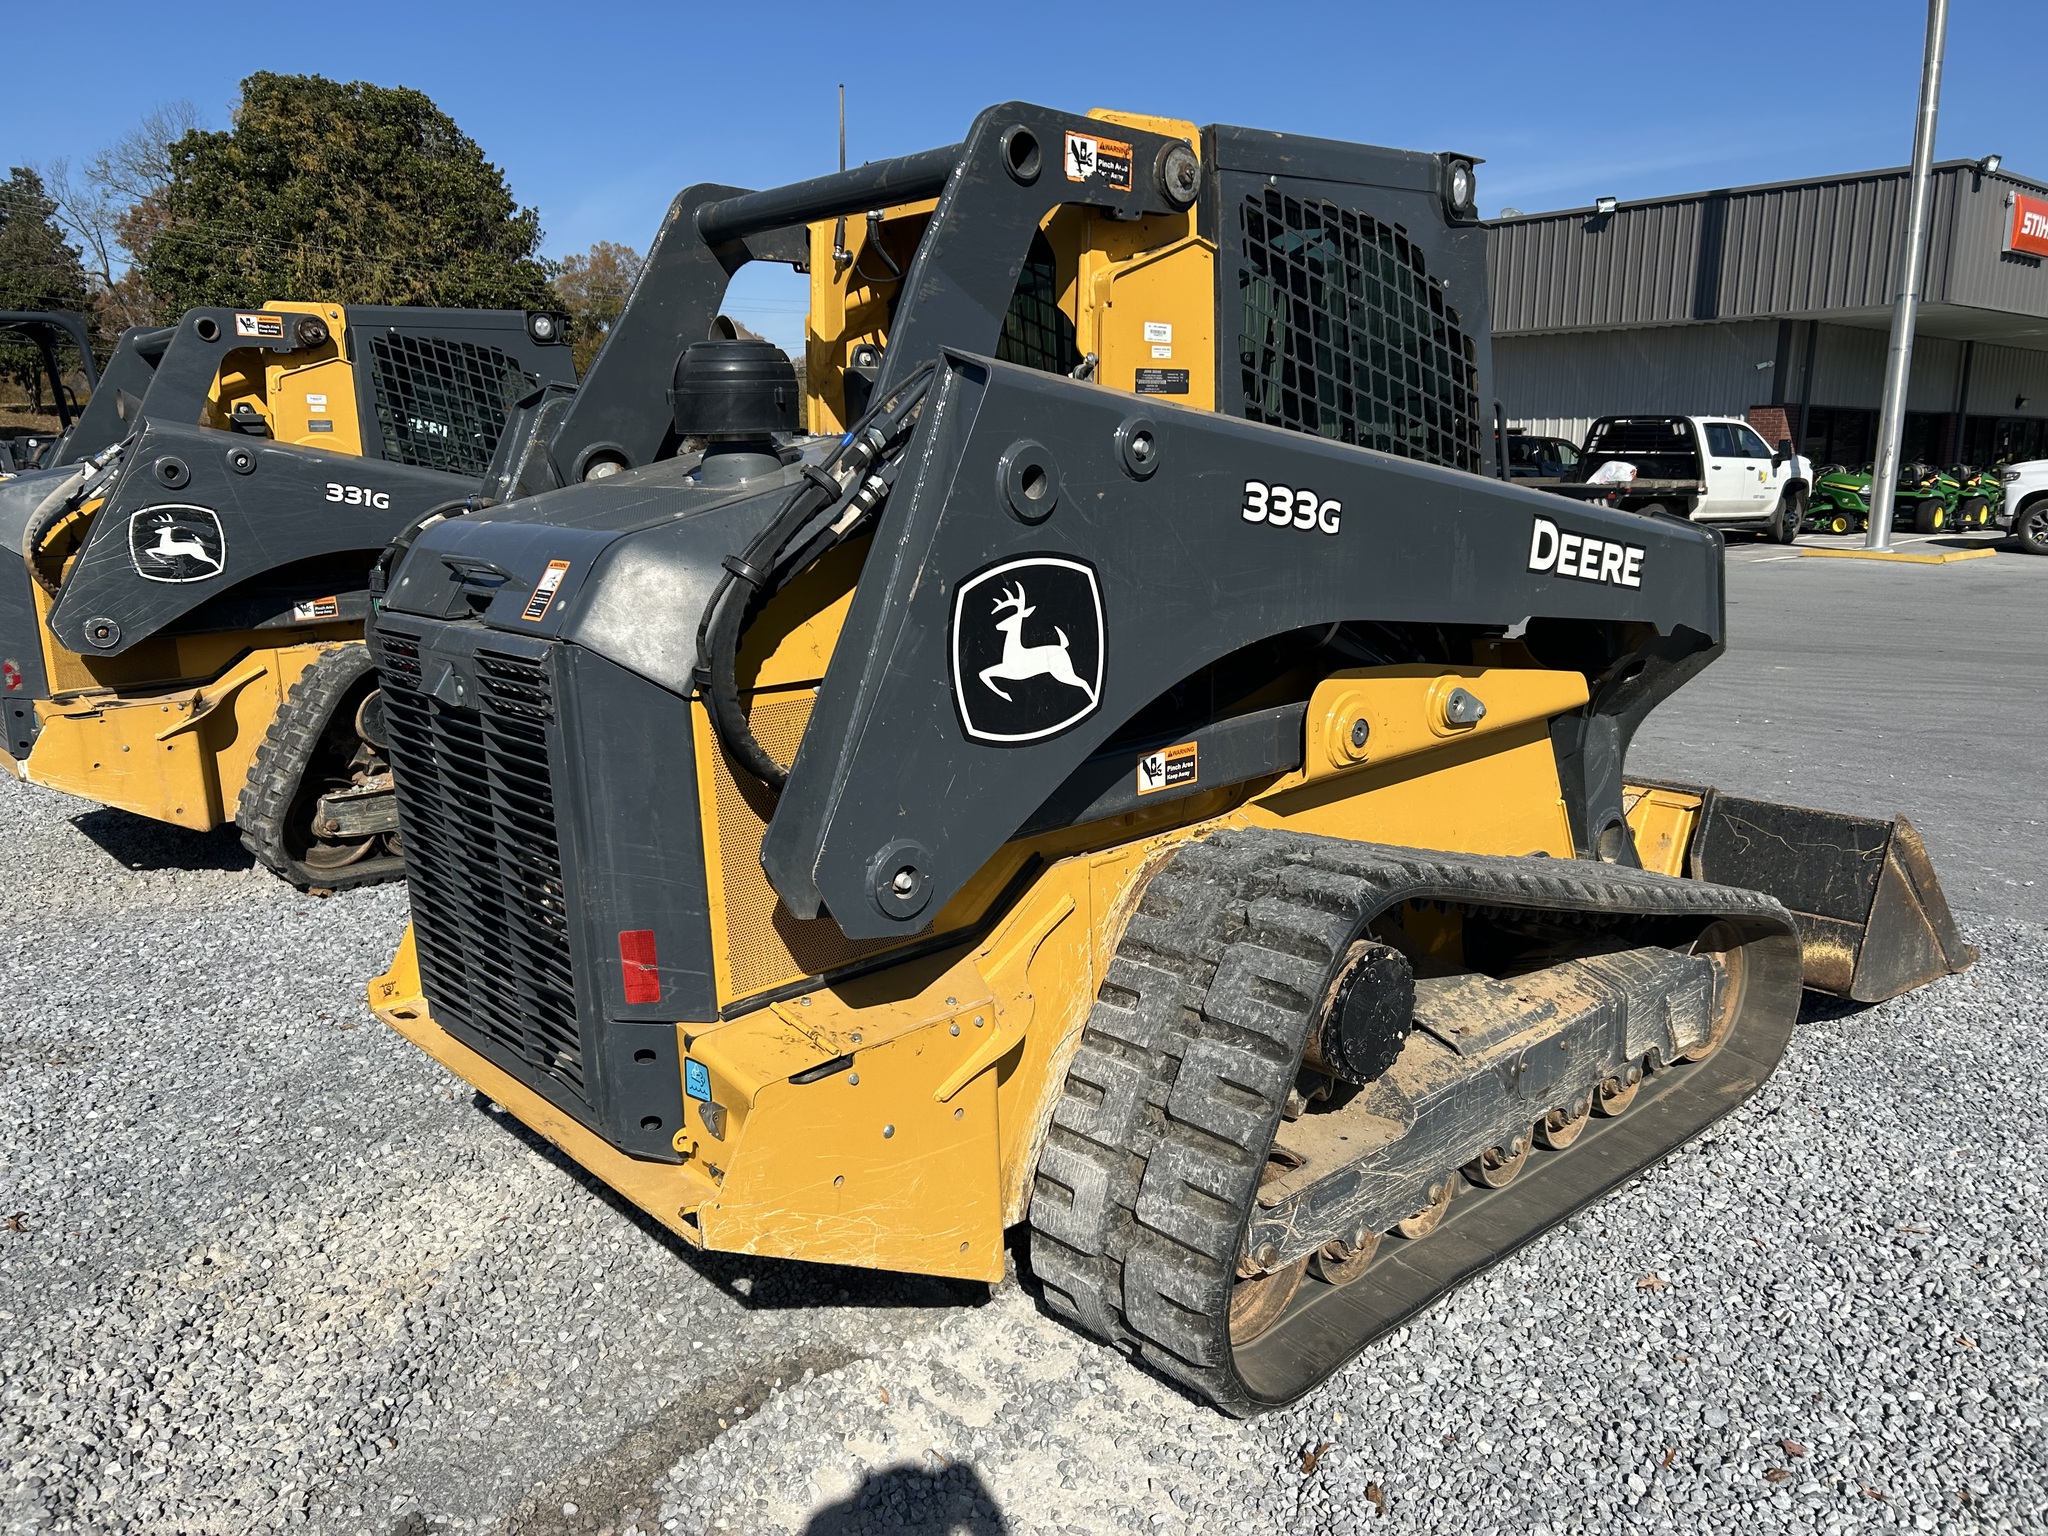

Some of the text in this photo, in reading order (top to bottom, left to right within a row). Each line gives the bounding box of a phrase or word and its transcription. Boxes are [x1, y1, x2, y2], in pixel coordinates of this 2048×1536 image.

[1098, 159, 1114, 169] Pinch
[325, 482, 390, 509] 331G
[1242, 481, 1342, 534] 333G
[1529, 518, 1645, 588] DEERE
[1172, 746, 1195, 756] WARNING
[1167, 761, 1194, 772] Pinch Area
